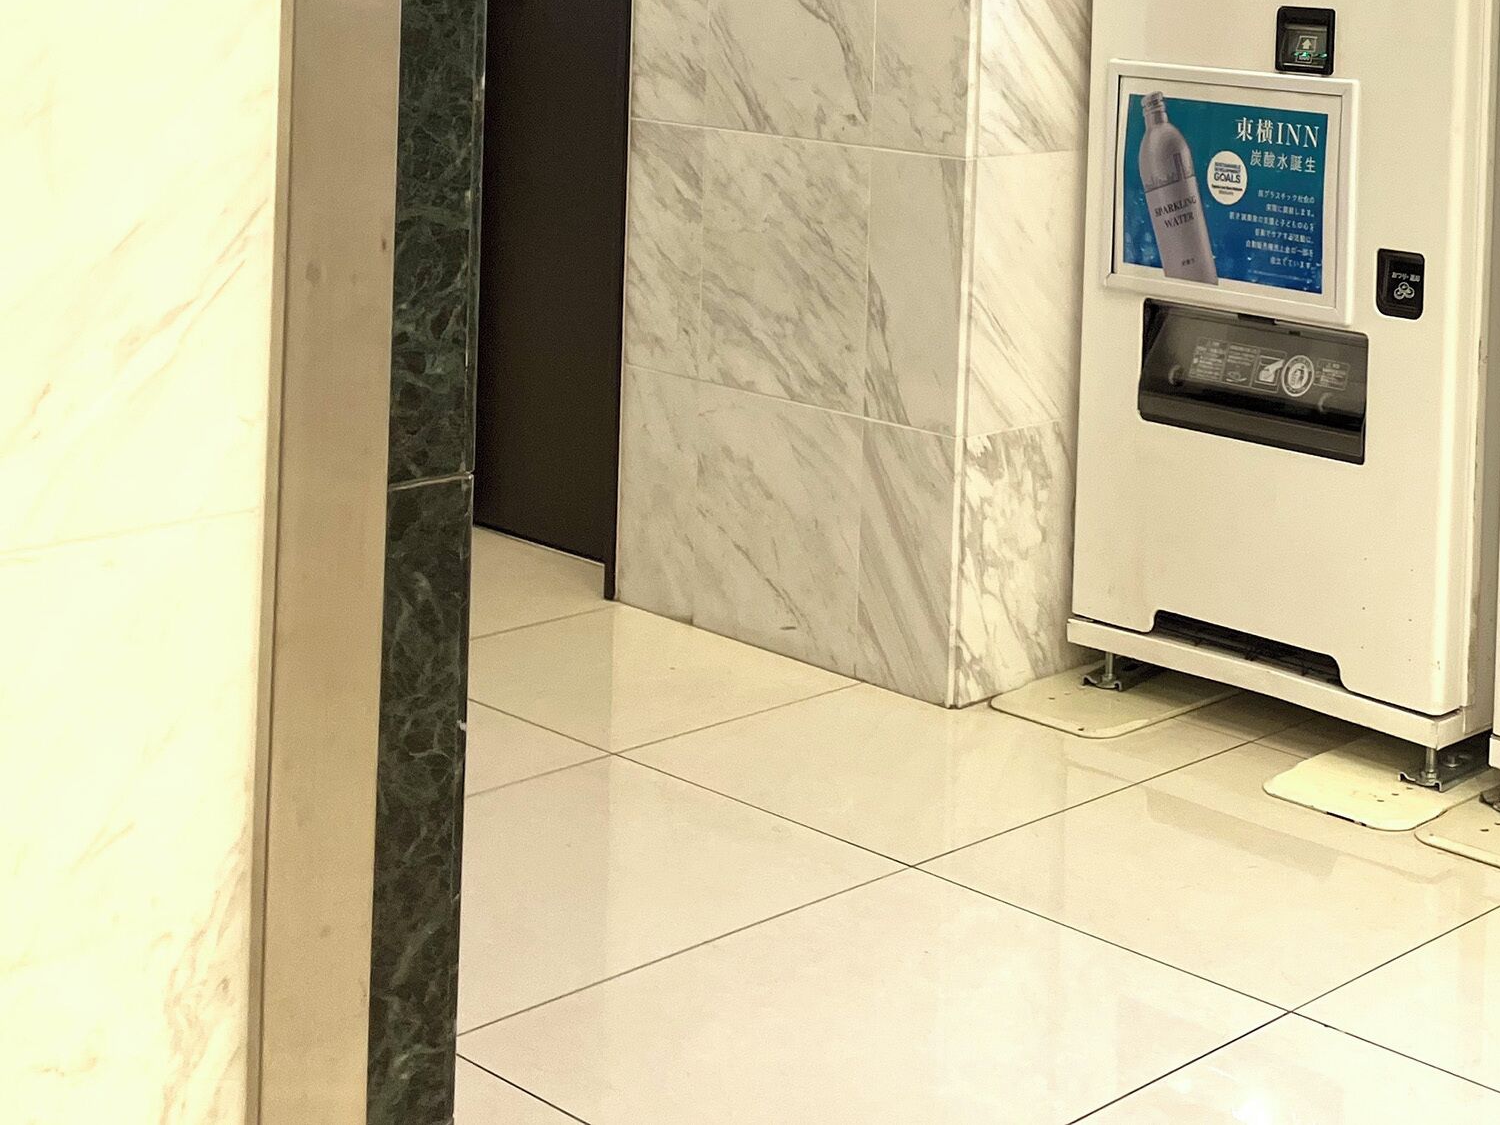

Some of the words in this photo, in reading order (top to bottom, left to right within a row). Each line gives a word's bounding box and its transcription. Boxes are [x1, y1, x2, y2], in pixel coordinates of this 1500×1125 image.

[1235, 117, 1319, 148] 東横INN
[1250, 150, 1316, 173] 炭酸水誕生
[1214, 172, 1241, 184] GOALS
[1155, 195, 1197, 217] SPARKLING
[1164, 211, 1195, 228] WATER
